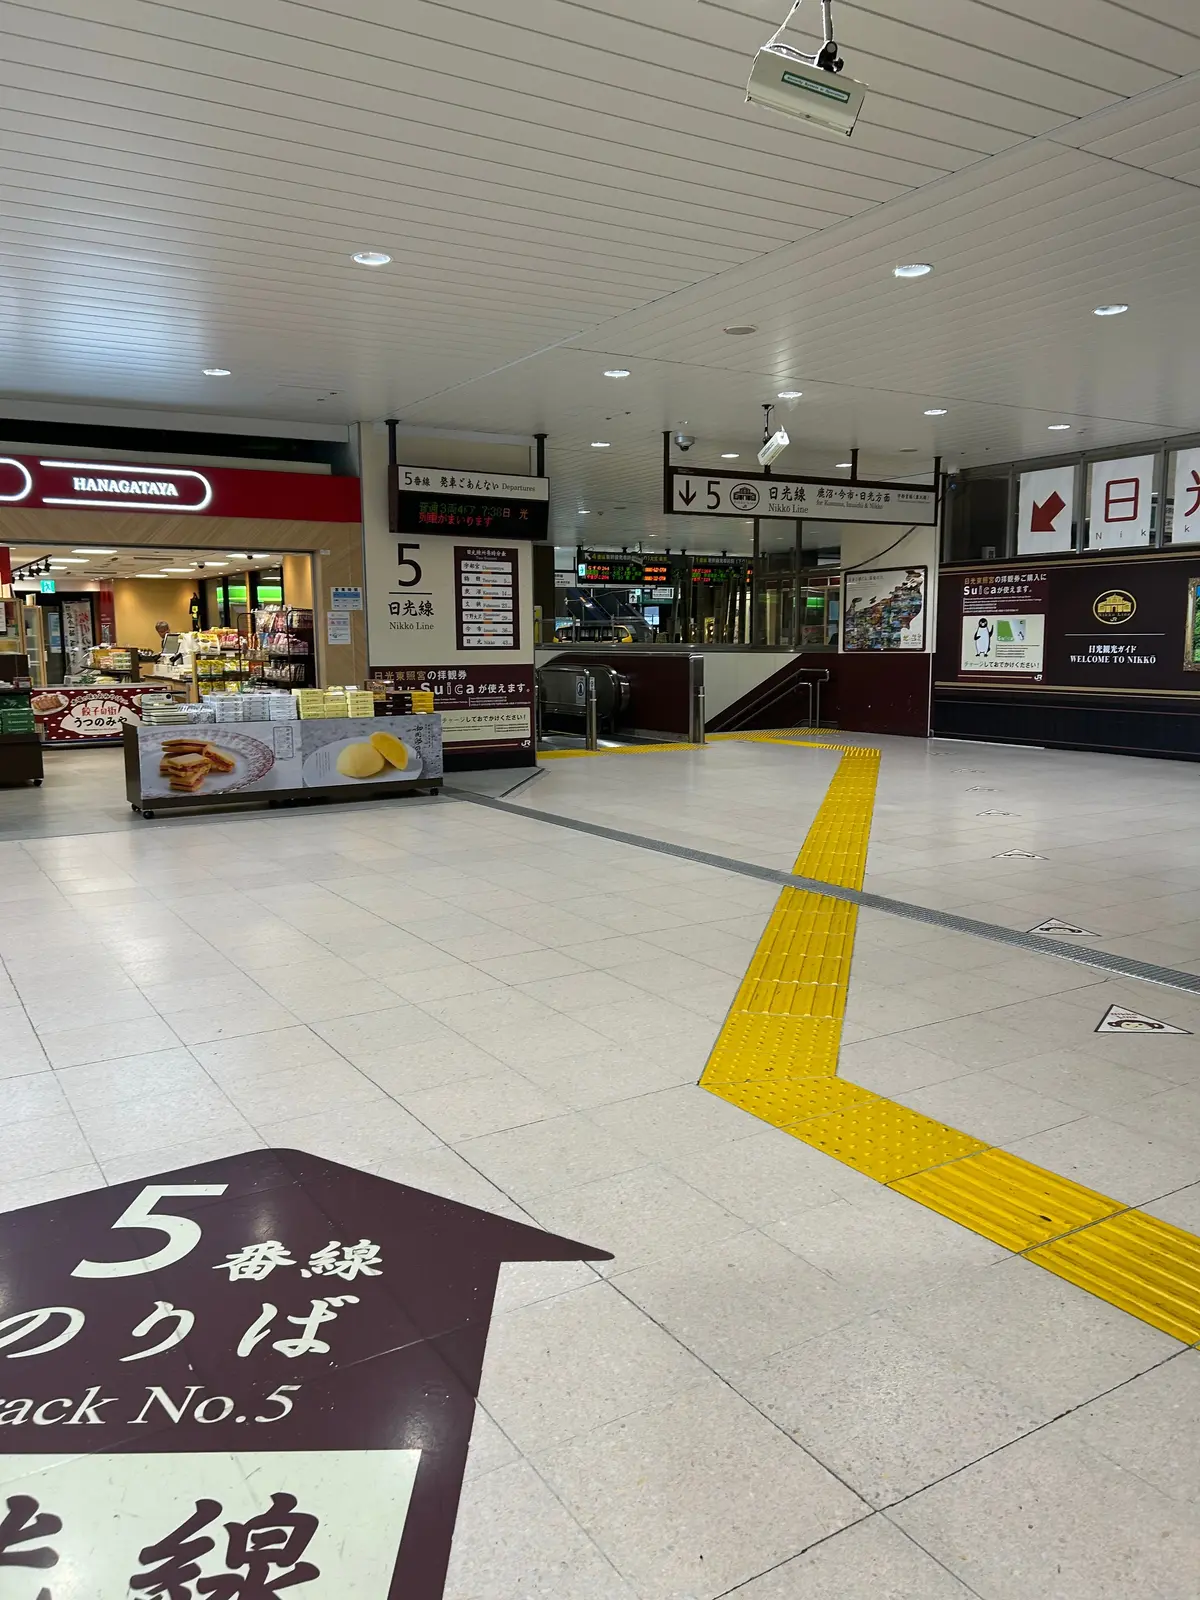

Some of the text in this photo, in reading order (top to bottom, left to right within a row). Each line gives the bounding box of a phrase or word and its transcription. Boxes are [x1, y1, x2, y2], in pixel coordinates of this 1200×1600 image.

[73, 477, 179, 496] HANAGATAYA
[404, 472, 536, 492] 5番線 発車ごあんない Departures
[706, 480, 721, 510] 5
[768, 486, 806, 502] 日光線
[792, 506, 808, 514] Line
[398, 543, 422, 587] 5
[388, 600, 435, 617] 日光線
[416, 621, 435, 631] Line
[1088, 644, 1137, 654] 日光観光ガイド
[1070, 654, 1157, 664] WELCOME TO NIKKŌ
[374, 669, 468, 681] 日光東照宮の拝観券
[420, 682, 475, 695] Suica
[74, 716, 128, 728] うつのみや
[70, 1183, 384, 1283] 5番線
[0, 1294, 361, 1363] のりば
[0, 1384, 302, 1426] ack No.5
